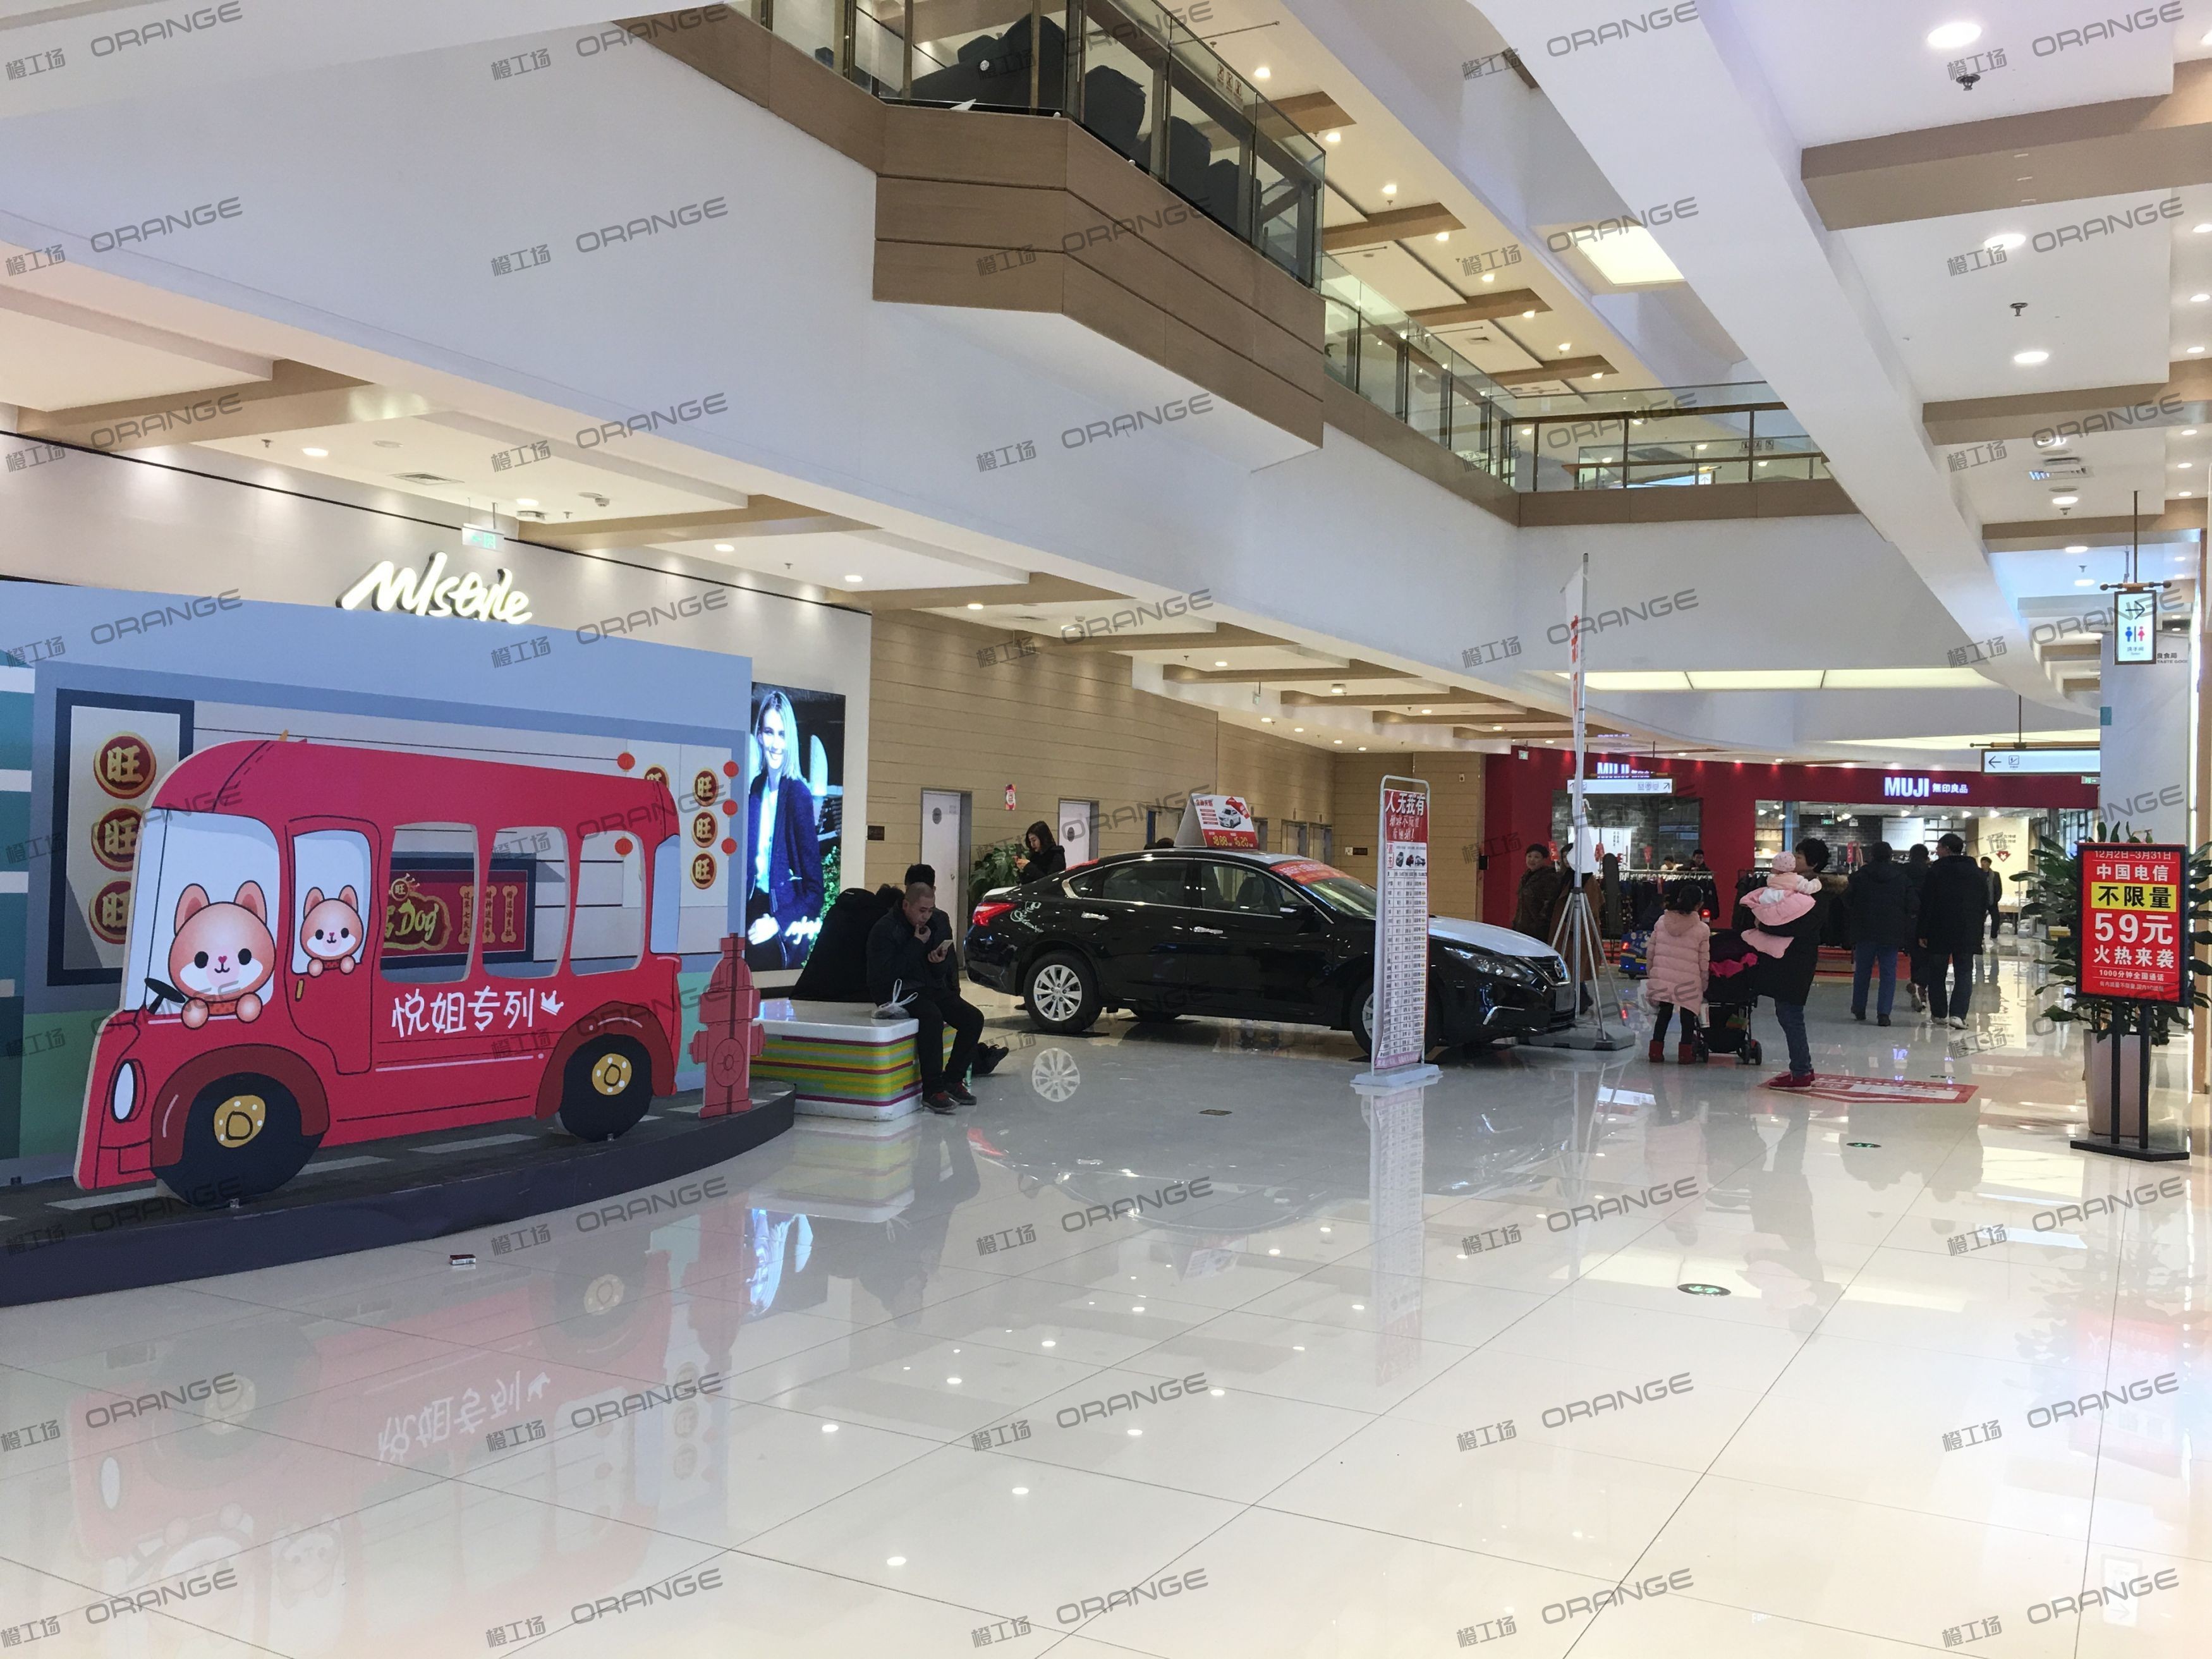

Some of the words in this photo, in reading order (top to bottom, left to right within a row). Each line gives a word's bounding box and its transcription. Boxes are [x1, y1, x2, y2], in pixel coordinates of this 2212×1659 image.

[106, 744, 143, 784] 旺
[697, 775, 714, 798] 旺
[1884, 777, 1929, 798] MUJI
[1932, 783, 1969, 794] 無印良品
[1385, 791, 1426, 816] 人无我有
[104, 817, 138, 856] 旺
[696, 817, 712, 839] 旺
[695, 858, 712, 880] 旺
[2096, 863, 2169, 882] 中国电信
[2098, 885, 2172, 909] 不限量
[395, 899, 439, 942] Dog
[2095, 913, 2173, 945] 59元
[2093, 945, 2174, 969] 火热来袭
[2099, 969, 2164, 981] 1000分钟全国通话
[391, 986, 534, 1038] 悦姐专列
